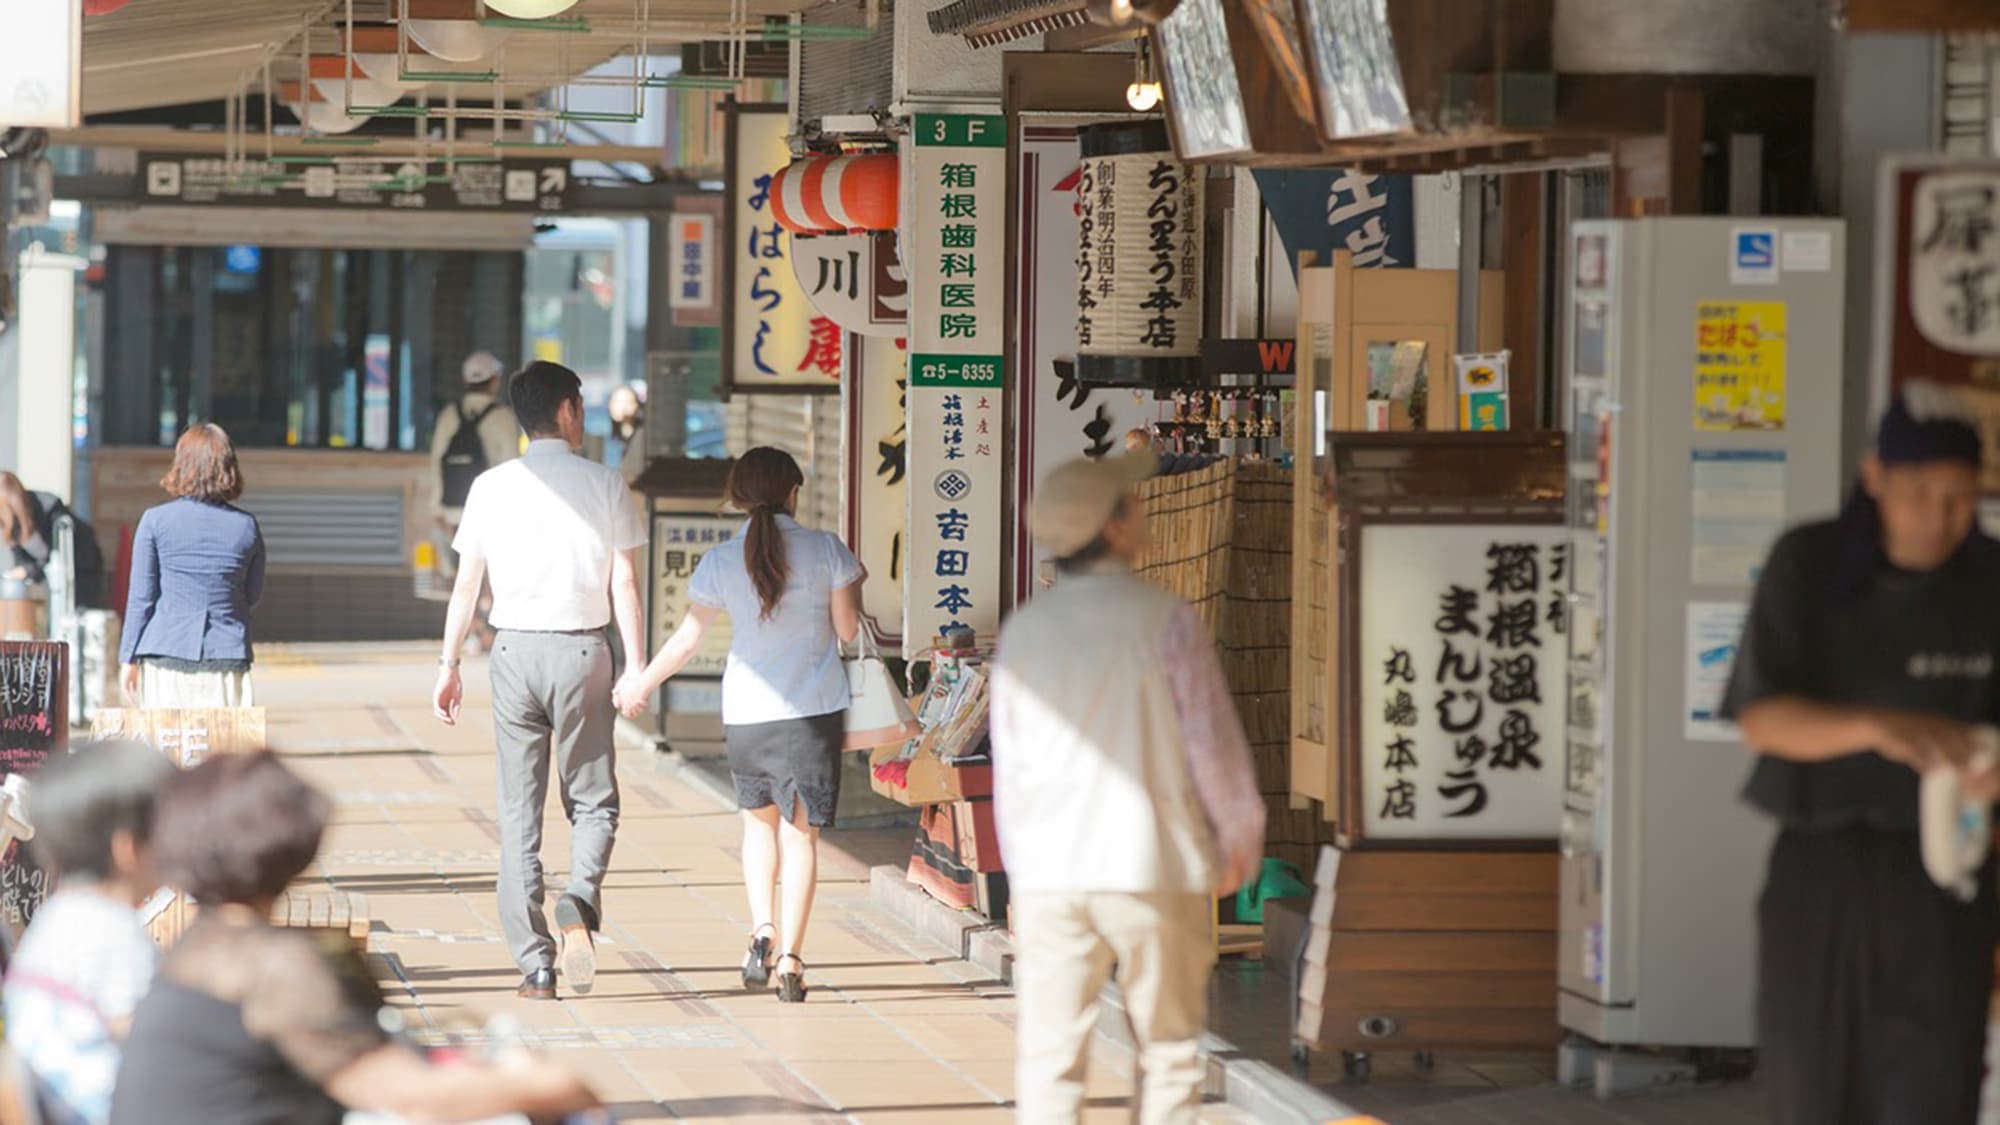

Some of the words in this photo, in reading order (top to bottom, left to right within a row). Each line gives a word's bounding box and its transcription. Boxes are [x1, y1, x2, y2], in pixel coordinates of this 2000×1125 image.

[813, 250, 860, 300] 川
[939, 162, 977, 339] 箱根歯科医院
[1097, 160, 1116, 298] 創業明治四年
[937, 363, 995, 382] 5-6355
[1697, 323, 1760, 348] たばこ
[1379, 645, 1419, 820] 丸嶋本店
[1434, 585, 1489, 818] まんじゅう
[1486, 541, 1542, 771] 箱根温泉
